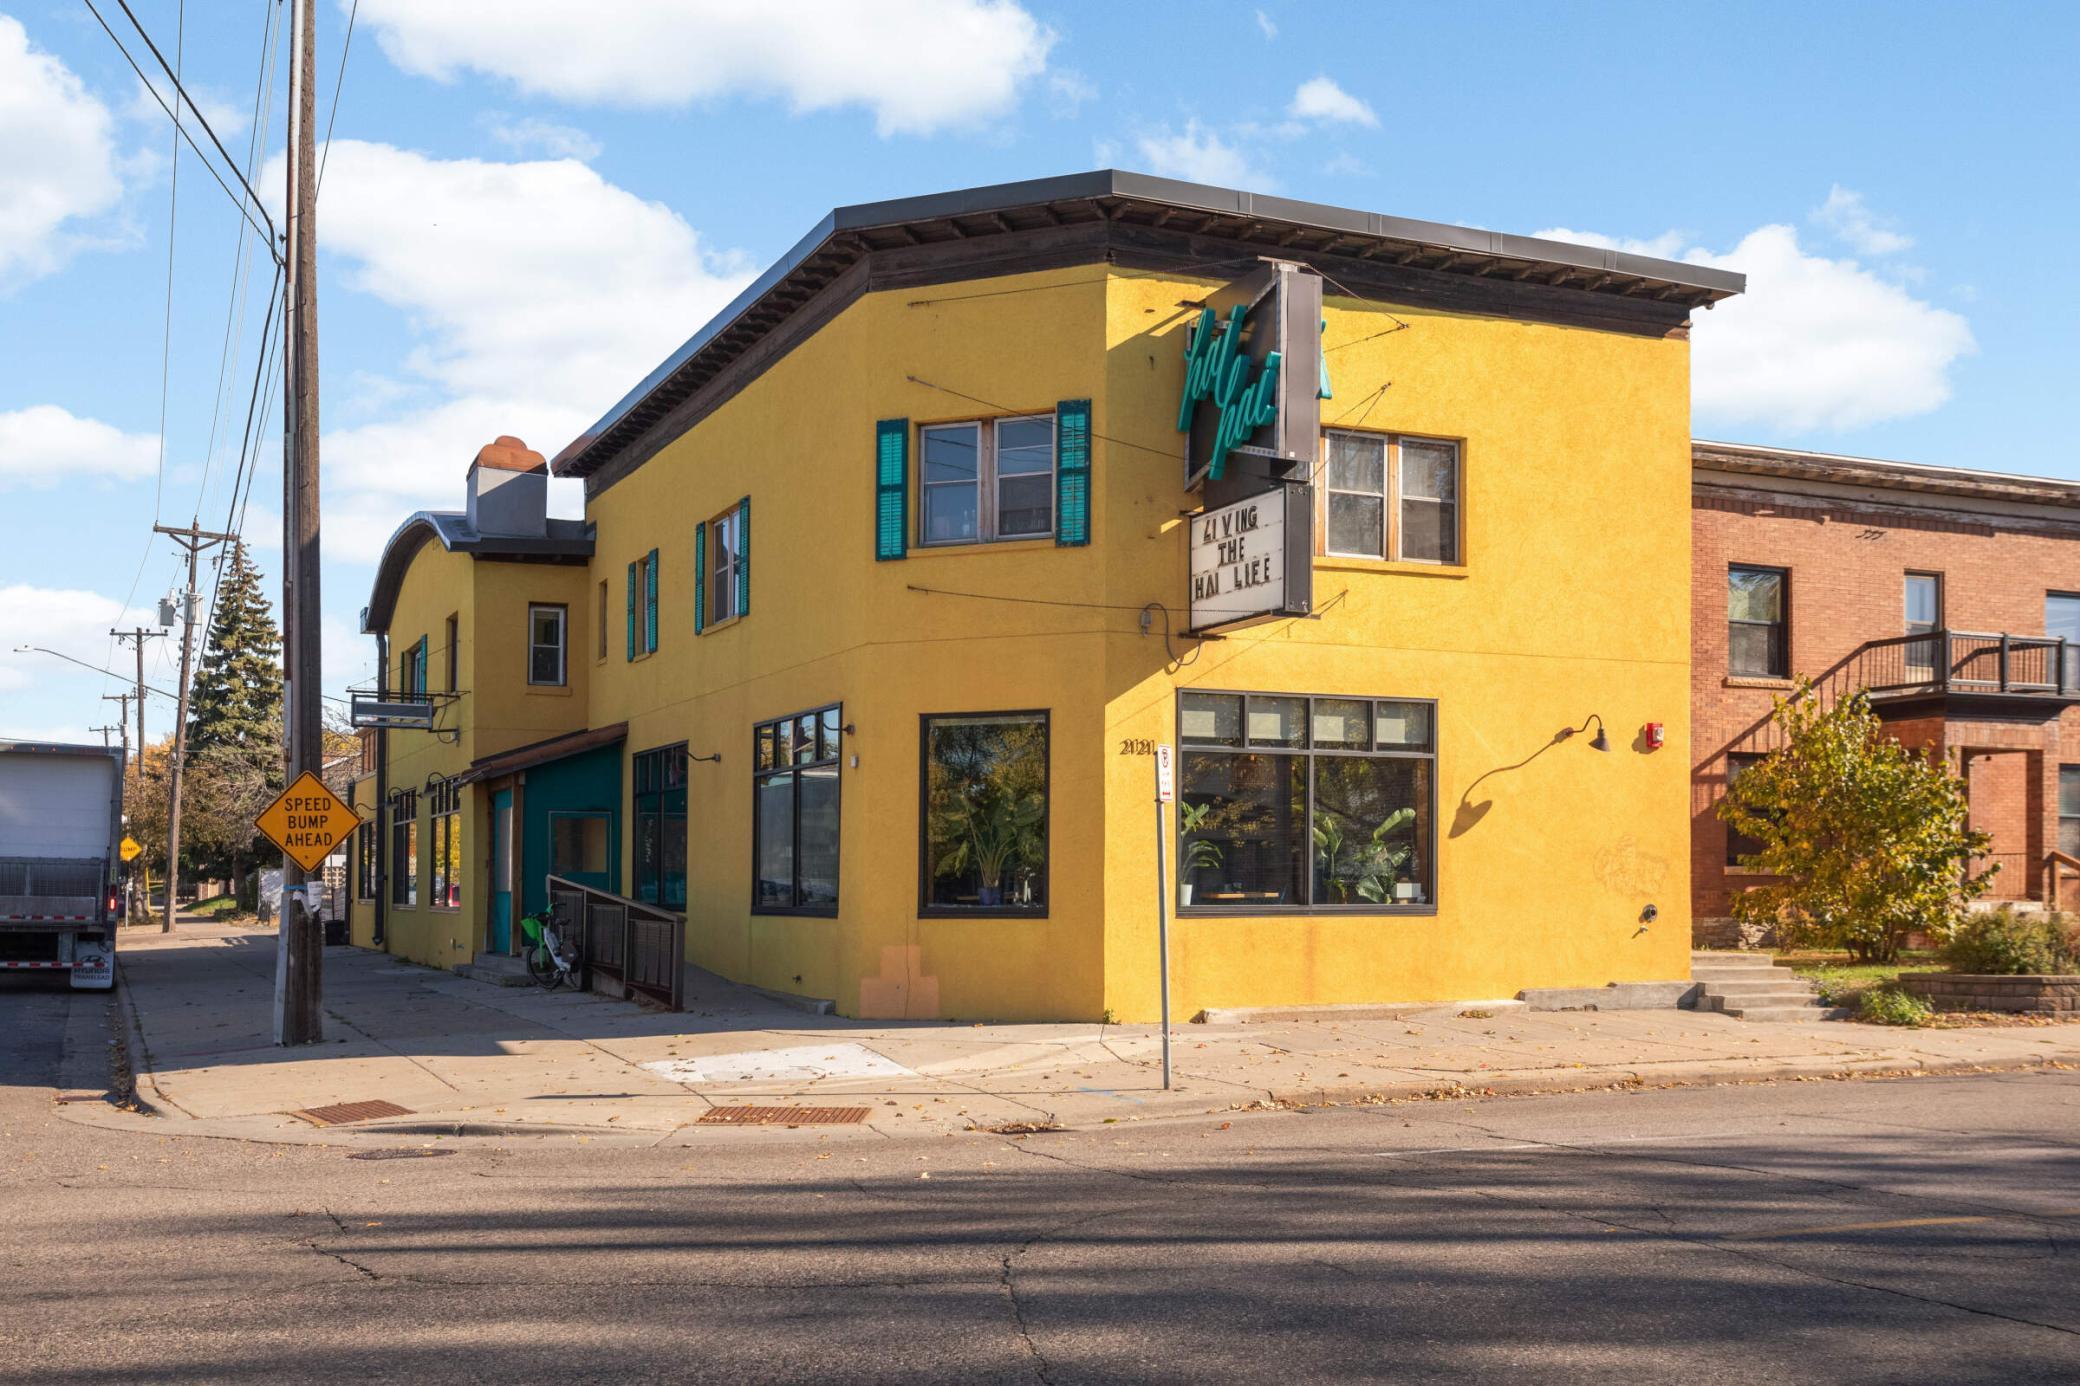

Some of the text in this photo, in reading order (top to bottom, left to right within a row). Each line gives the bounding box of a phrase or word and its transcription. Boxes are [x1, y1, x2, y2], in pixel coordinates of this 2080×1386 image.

[1204, 505, 1258, 542] LIVING
[1218, 537, 1245, 566] THE
[1195, 558, 1270, 600] HAI LIFE
[284, 797, 331, 812] SPEED
[288, 815, 328, 829] BUMP
[285, 833, 332, 847] AHEAD
